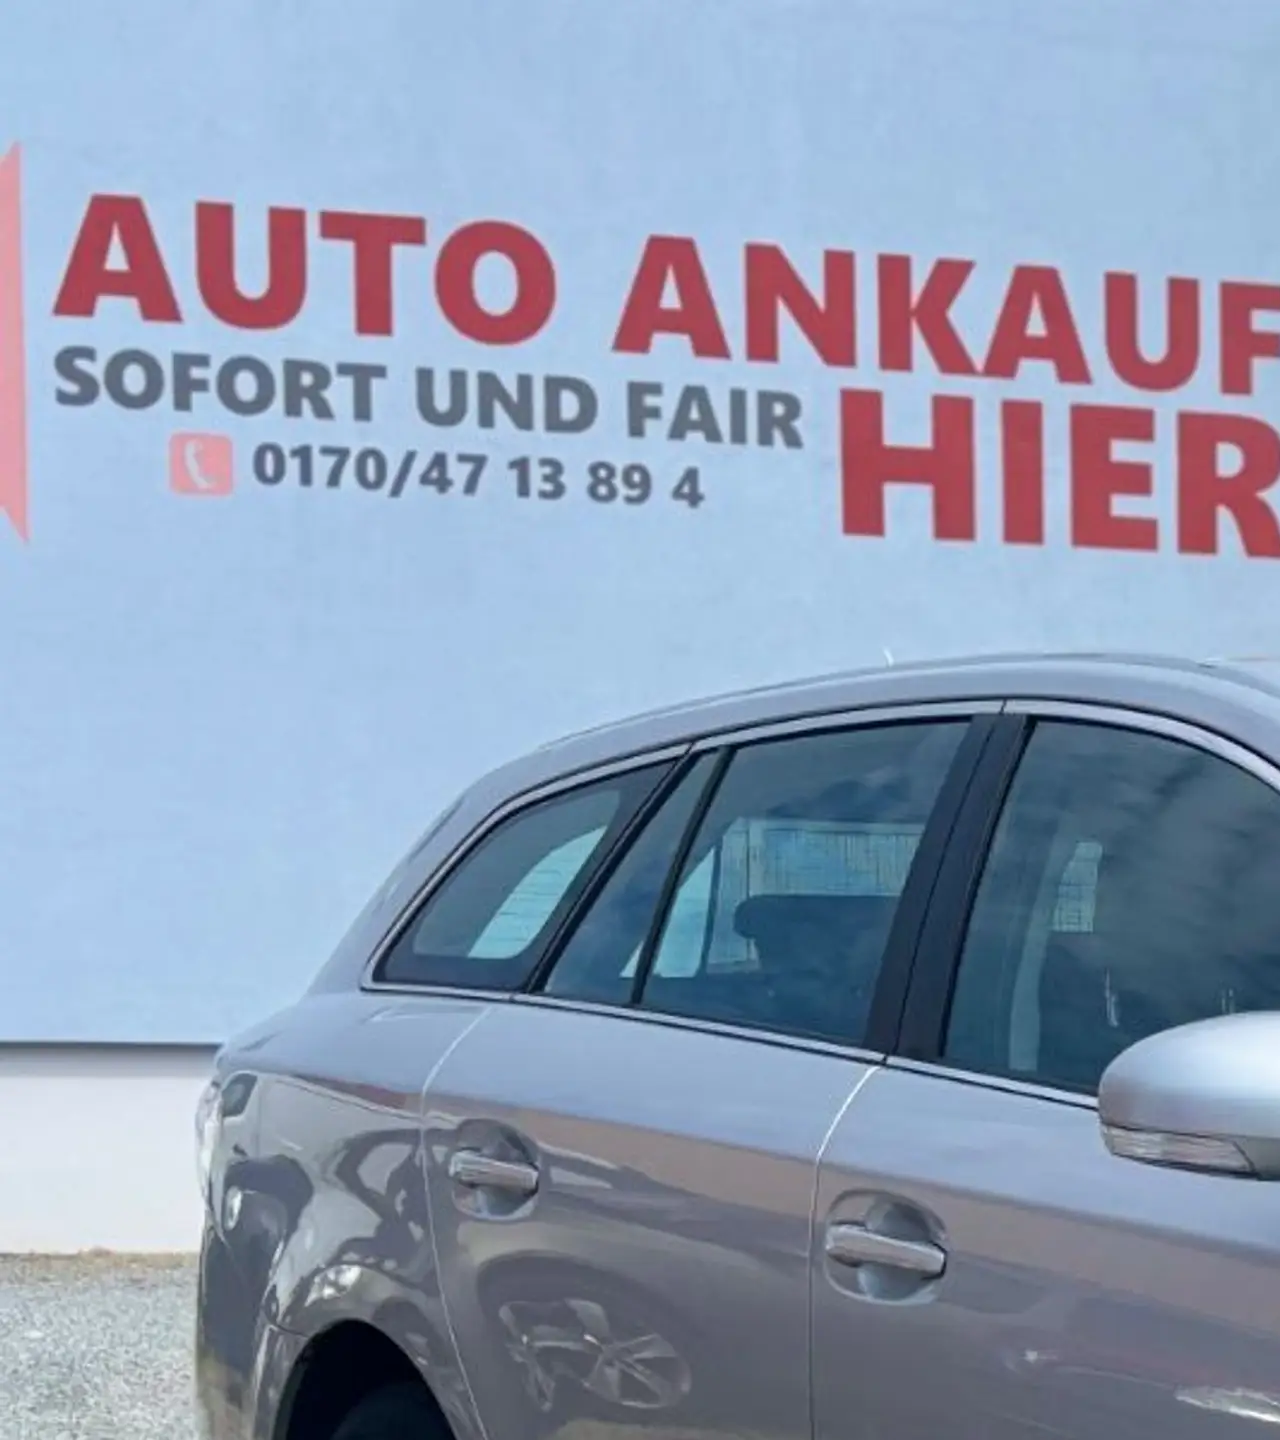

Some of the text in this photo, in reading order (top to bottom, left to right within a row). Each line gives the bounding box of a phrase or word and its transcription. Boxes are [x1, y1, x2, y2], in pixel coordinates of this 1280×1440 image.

[54, 193, 557, 344] AUTO
[53, 346, 803, 450] SOFORT UND FAIR
[252, 443, 704, 508] 0170/47 13 89 4
